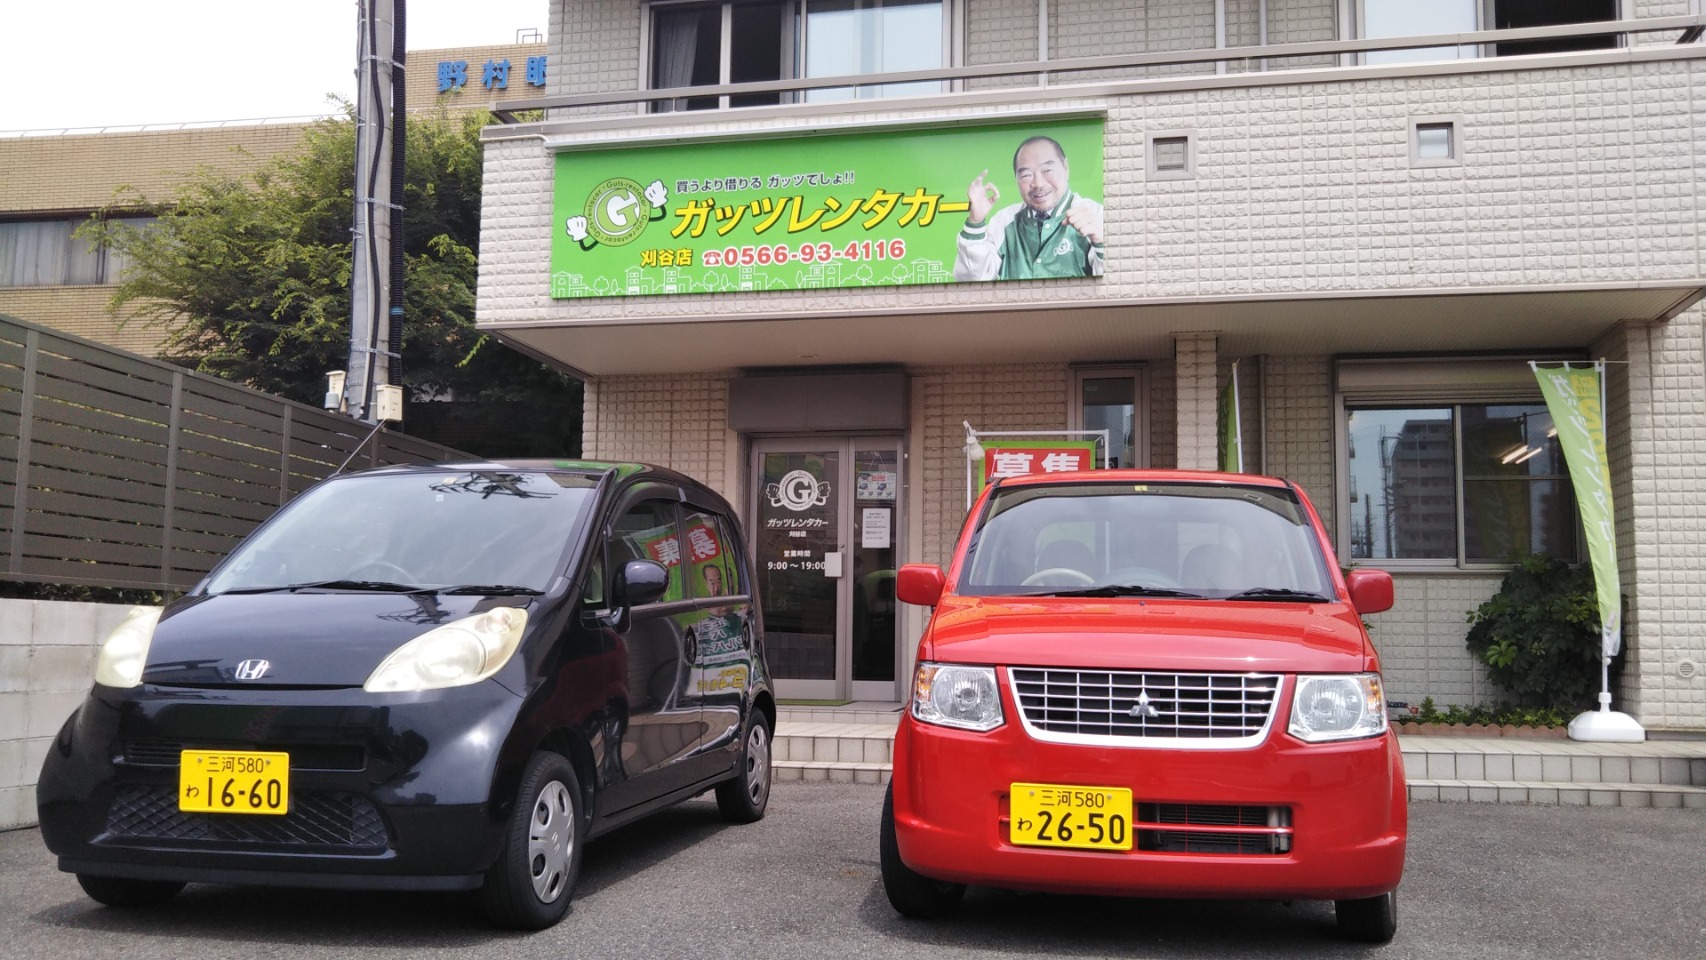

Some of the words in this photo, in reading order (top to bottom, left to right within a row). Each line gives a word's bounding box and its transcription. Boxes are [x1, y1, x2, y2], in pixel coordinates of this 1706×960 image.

[676, 176, 763, 193] 買うより借りる
[670, 187, 971, 239] ガッツレンタカー
[640, 249, 693, 268] 刈谷店
[723, 239, 906, 267] 0566-93-4116
[766, 517, 829, 528] ガッツレンタカー
[783, 549, 811, 558] 営業時間
[767, 561, 788, 571] 9:00
[801, 561, 826, 571] 19:00
[185, 784, 199, 798] わ
[208, 777, 281, 809] 16-60
[1017, 817, 1033, 831] わ
[1037, 810, 1125, 844] 26-50
